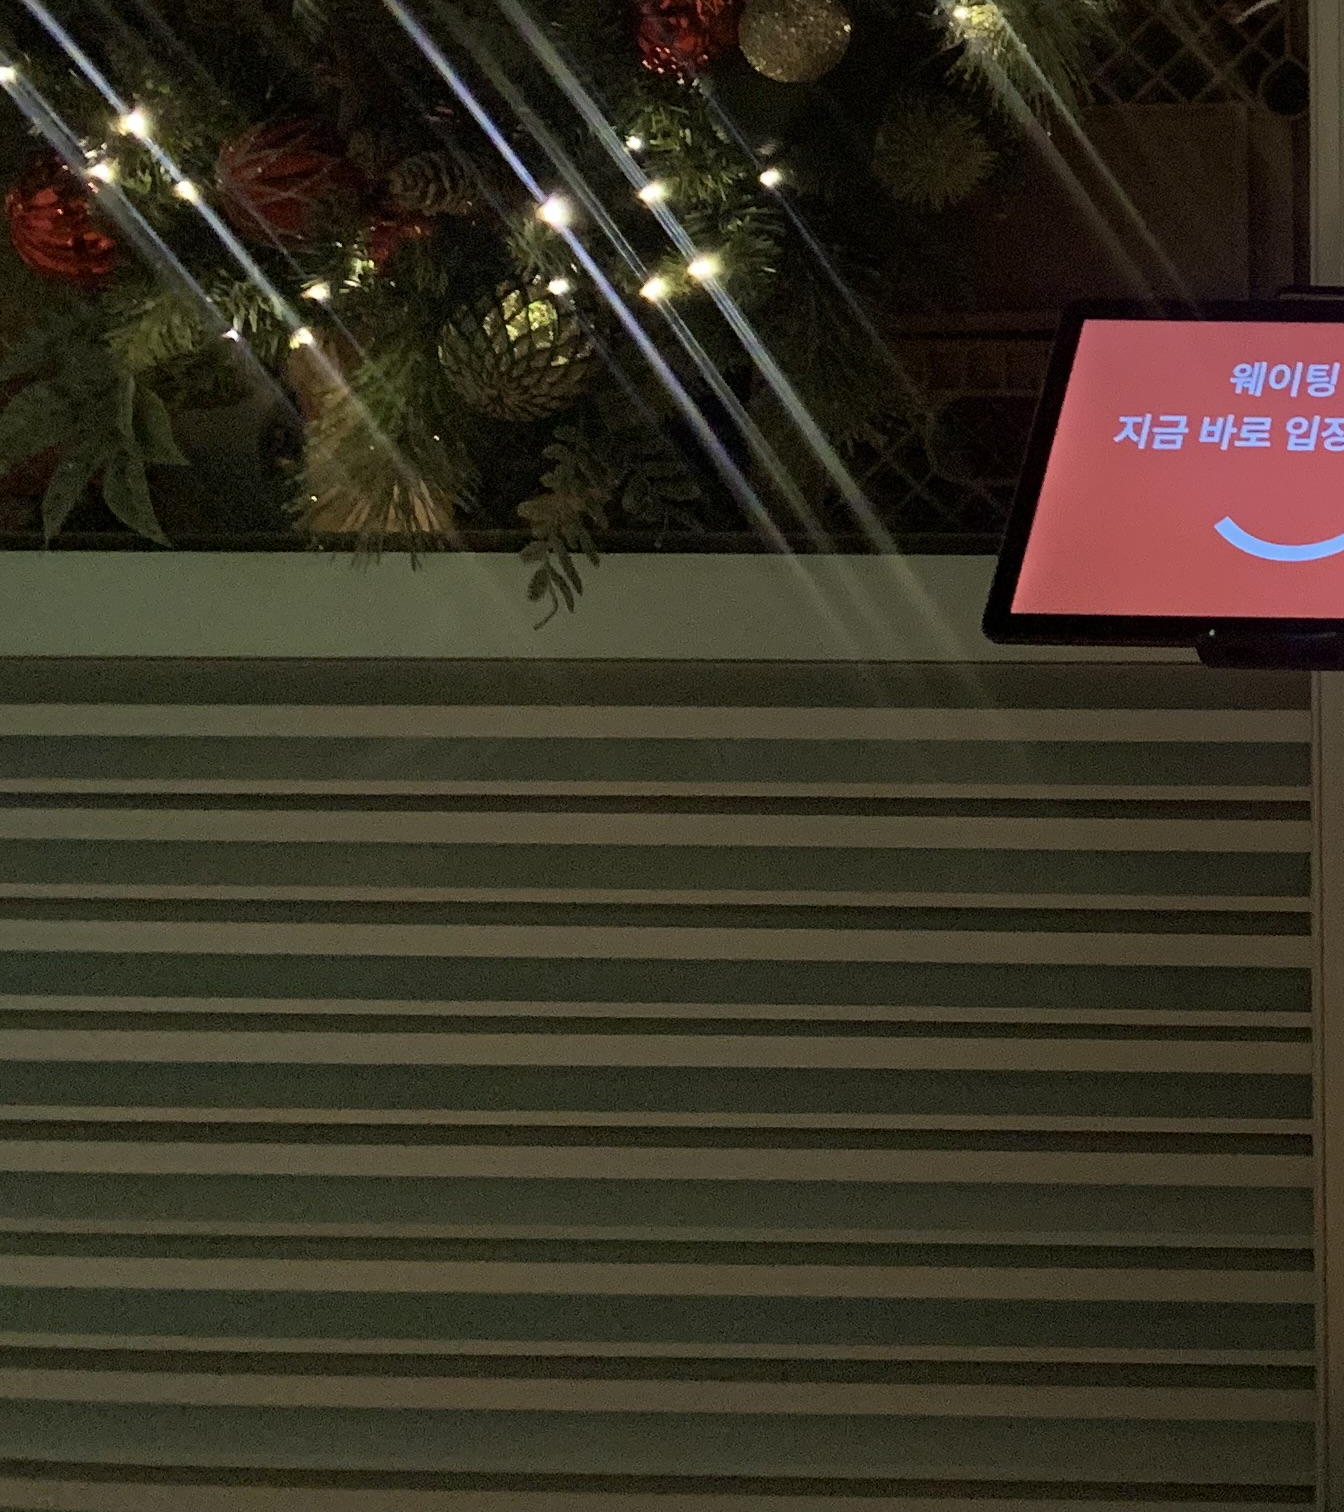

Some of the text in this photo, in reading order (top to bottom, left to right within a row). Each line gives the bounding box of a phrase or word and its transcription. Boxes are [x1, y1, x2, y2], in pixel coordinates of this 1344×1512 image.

[1229, 361, 1341, 398] 웨이팅
[1112, 413, 1190, 451] 지금
[1198, 415, 1273, 452] 바로
